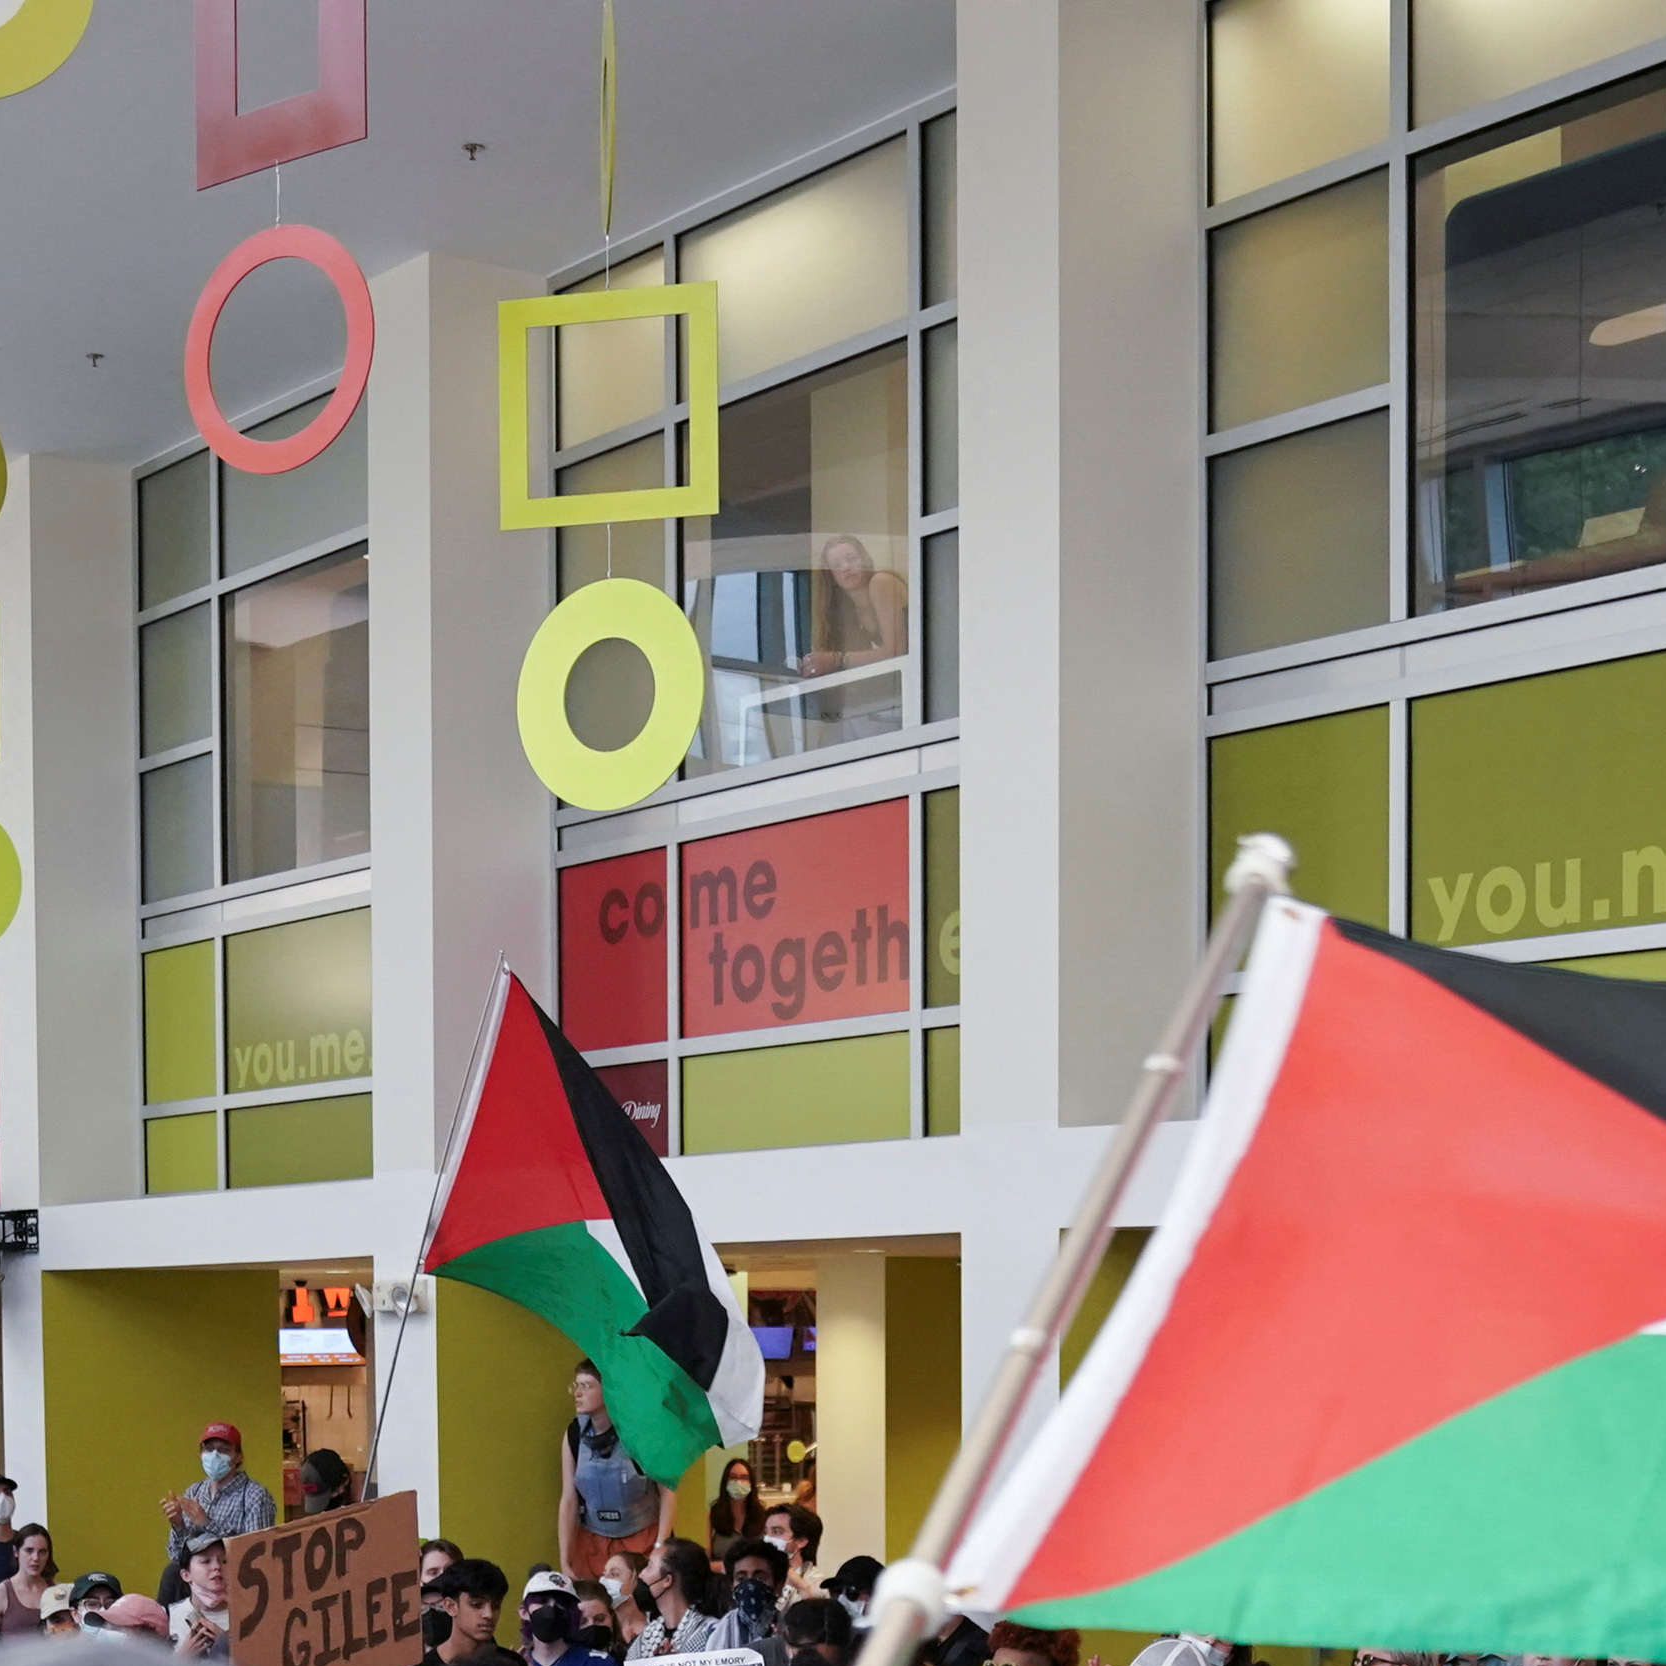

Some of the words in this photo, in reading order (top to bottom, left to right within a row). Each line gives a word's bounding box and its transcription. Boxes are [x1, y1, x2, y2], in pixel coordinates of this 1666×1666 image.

[708, 904, 961, 1021] togethe
[621, 1100, 662, 1129] Dining
[237, 1517, 366, 1641] STOP
[699, 1659, 714, 1666] MY
[716, 1656, 746, 1665] EMORY
